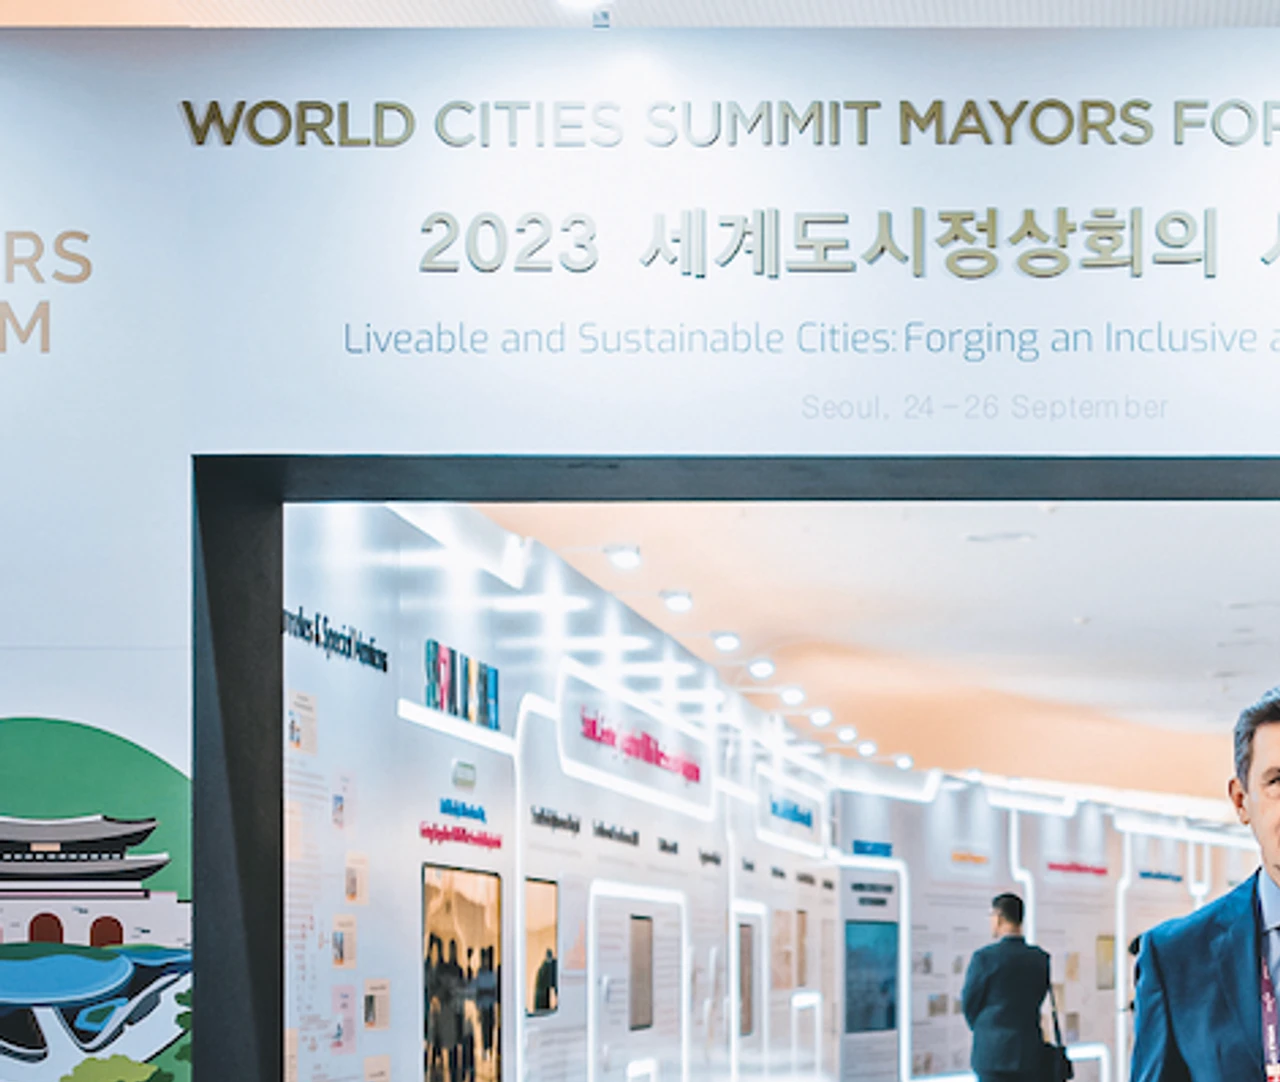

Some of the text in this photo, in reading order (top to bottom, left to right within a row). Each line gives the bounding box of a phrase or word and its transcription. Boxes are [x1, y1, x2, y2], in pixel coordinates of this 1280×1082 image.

[181, 99, 417, 148] WORLD
[433, 99, 624, 148] CITIES
[644, 99, 882, 148] SUMMIT
[898, 98, 1155, 147] MAYORS
[418, 211, 600, 275] 2023
[639, 206, 1218, 281] 세계도시정상회의
[343, 321, 489, 354] Liveable
[500, 322, 565, 354] and
[578, 321, 785, 354] Sustainable
[797, 321, 897, 354] Cities:
[904, 321, 1041, 363] Forging
[1050, 328, 1093, 353] an
[1105, 320, 1257, 353] Inclusive
[801, 394, 890, 422] Seoul,
[1010, 394, 1169, 423] September
